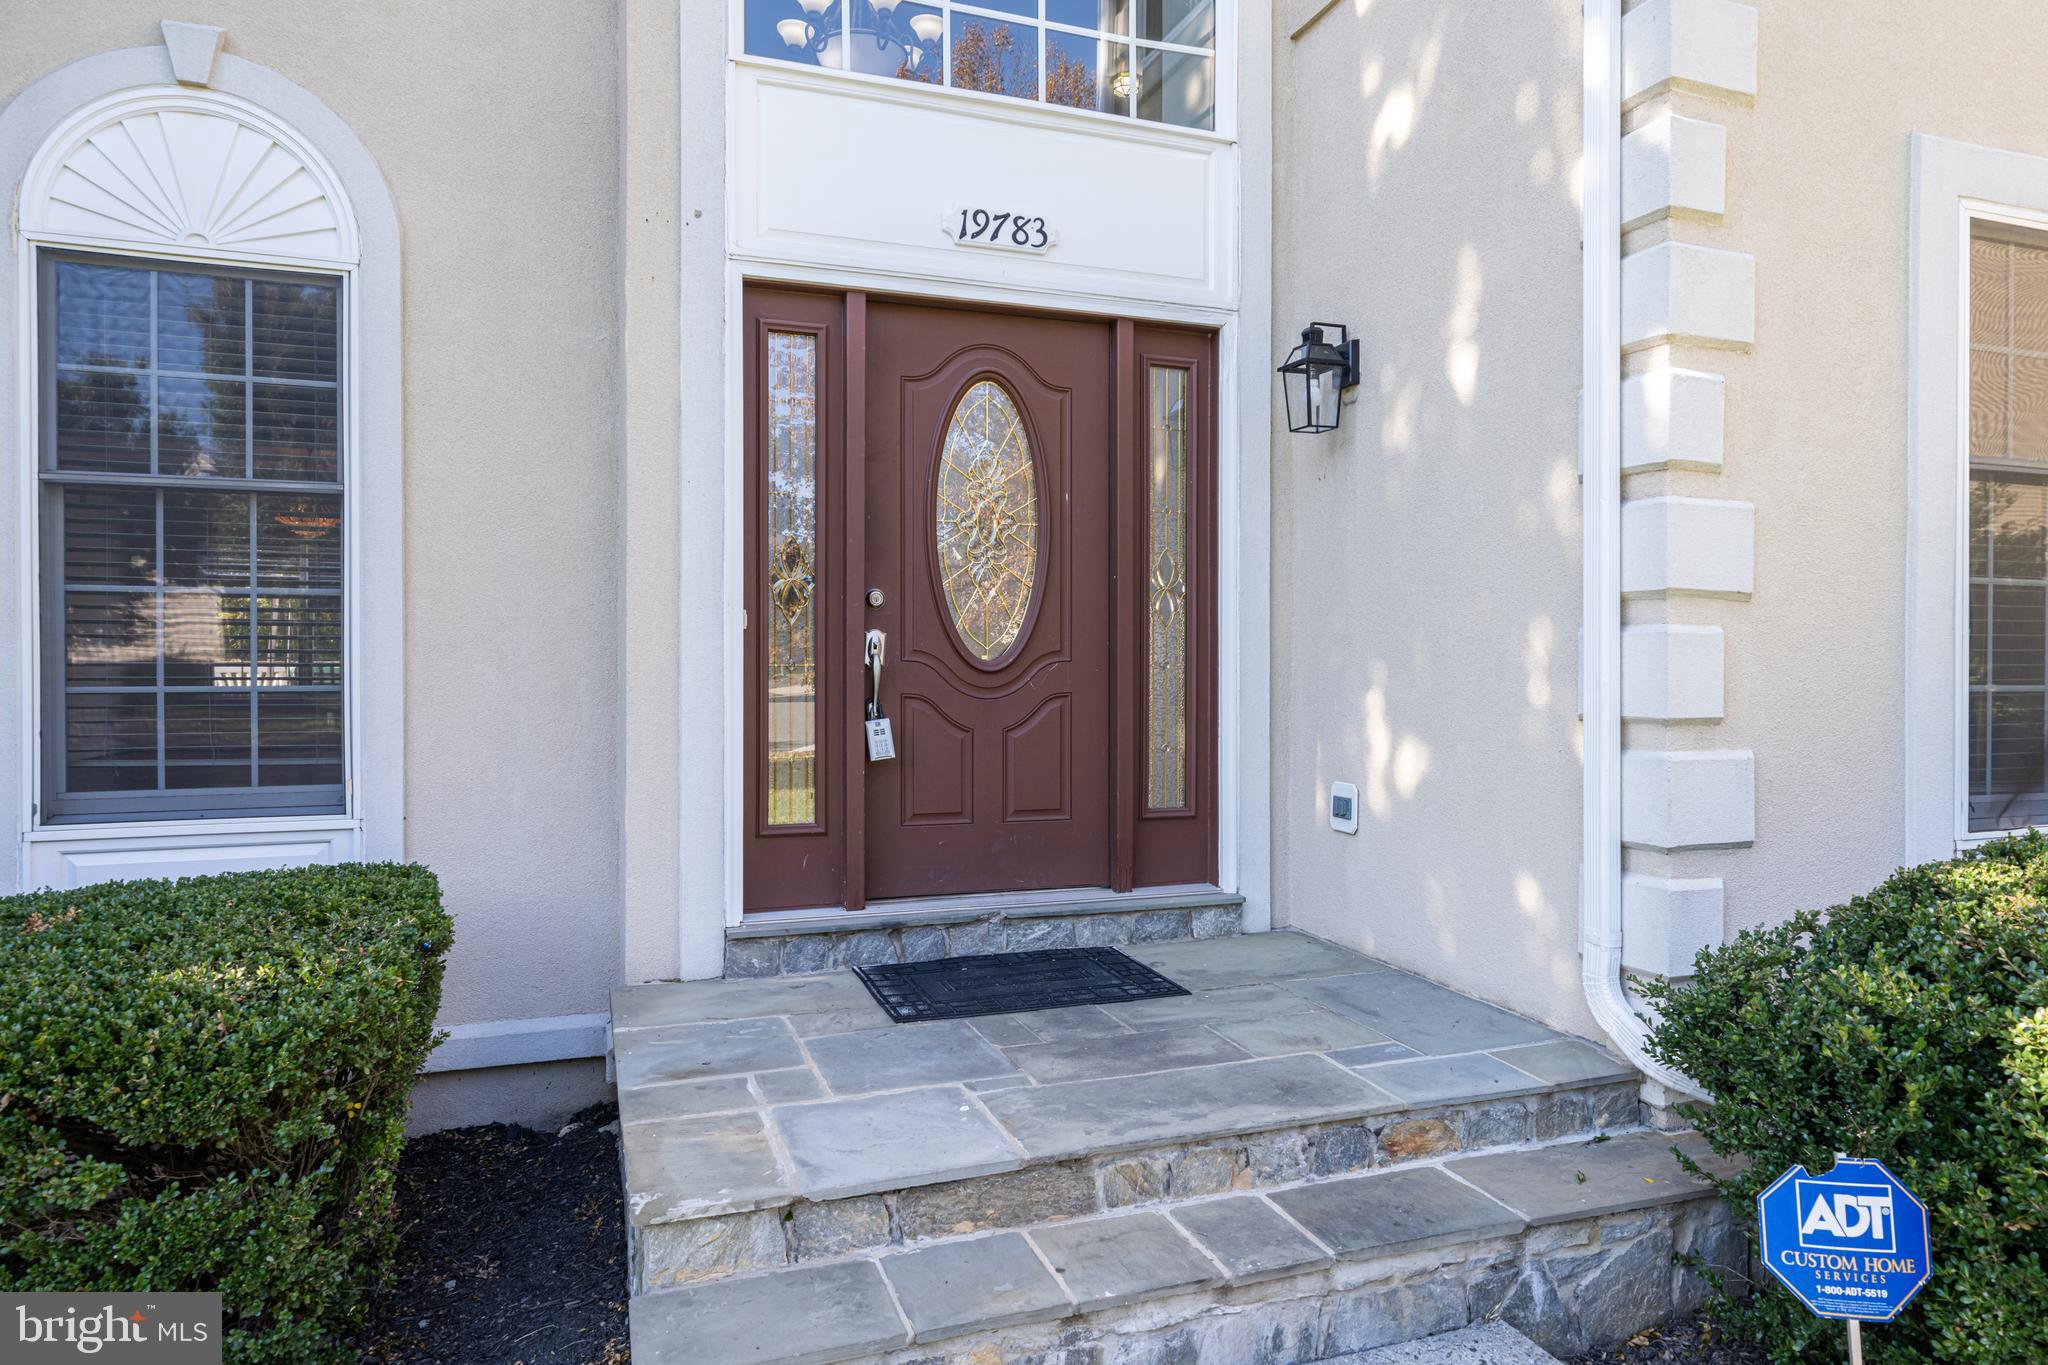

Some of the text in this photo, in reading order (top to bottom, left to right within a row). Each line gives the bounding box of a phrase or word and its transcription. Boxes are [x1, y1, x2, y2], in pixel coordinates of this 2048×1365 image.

[959, 209, 1048, 248] 19783
[1802, 1193, 1891, 1240] ADT
[1781, 1250, 1916, 1273] CUSTOM HOME
[1815, 1270, 1886, 1284] SERVICES
[1816, 1285, 1888, 1298] 1-800-ADT-5519
